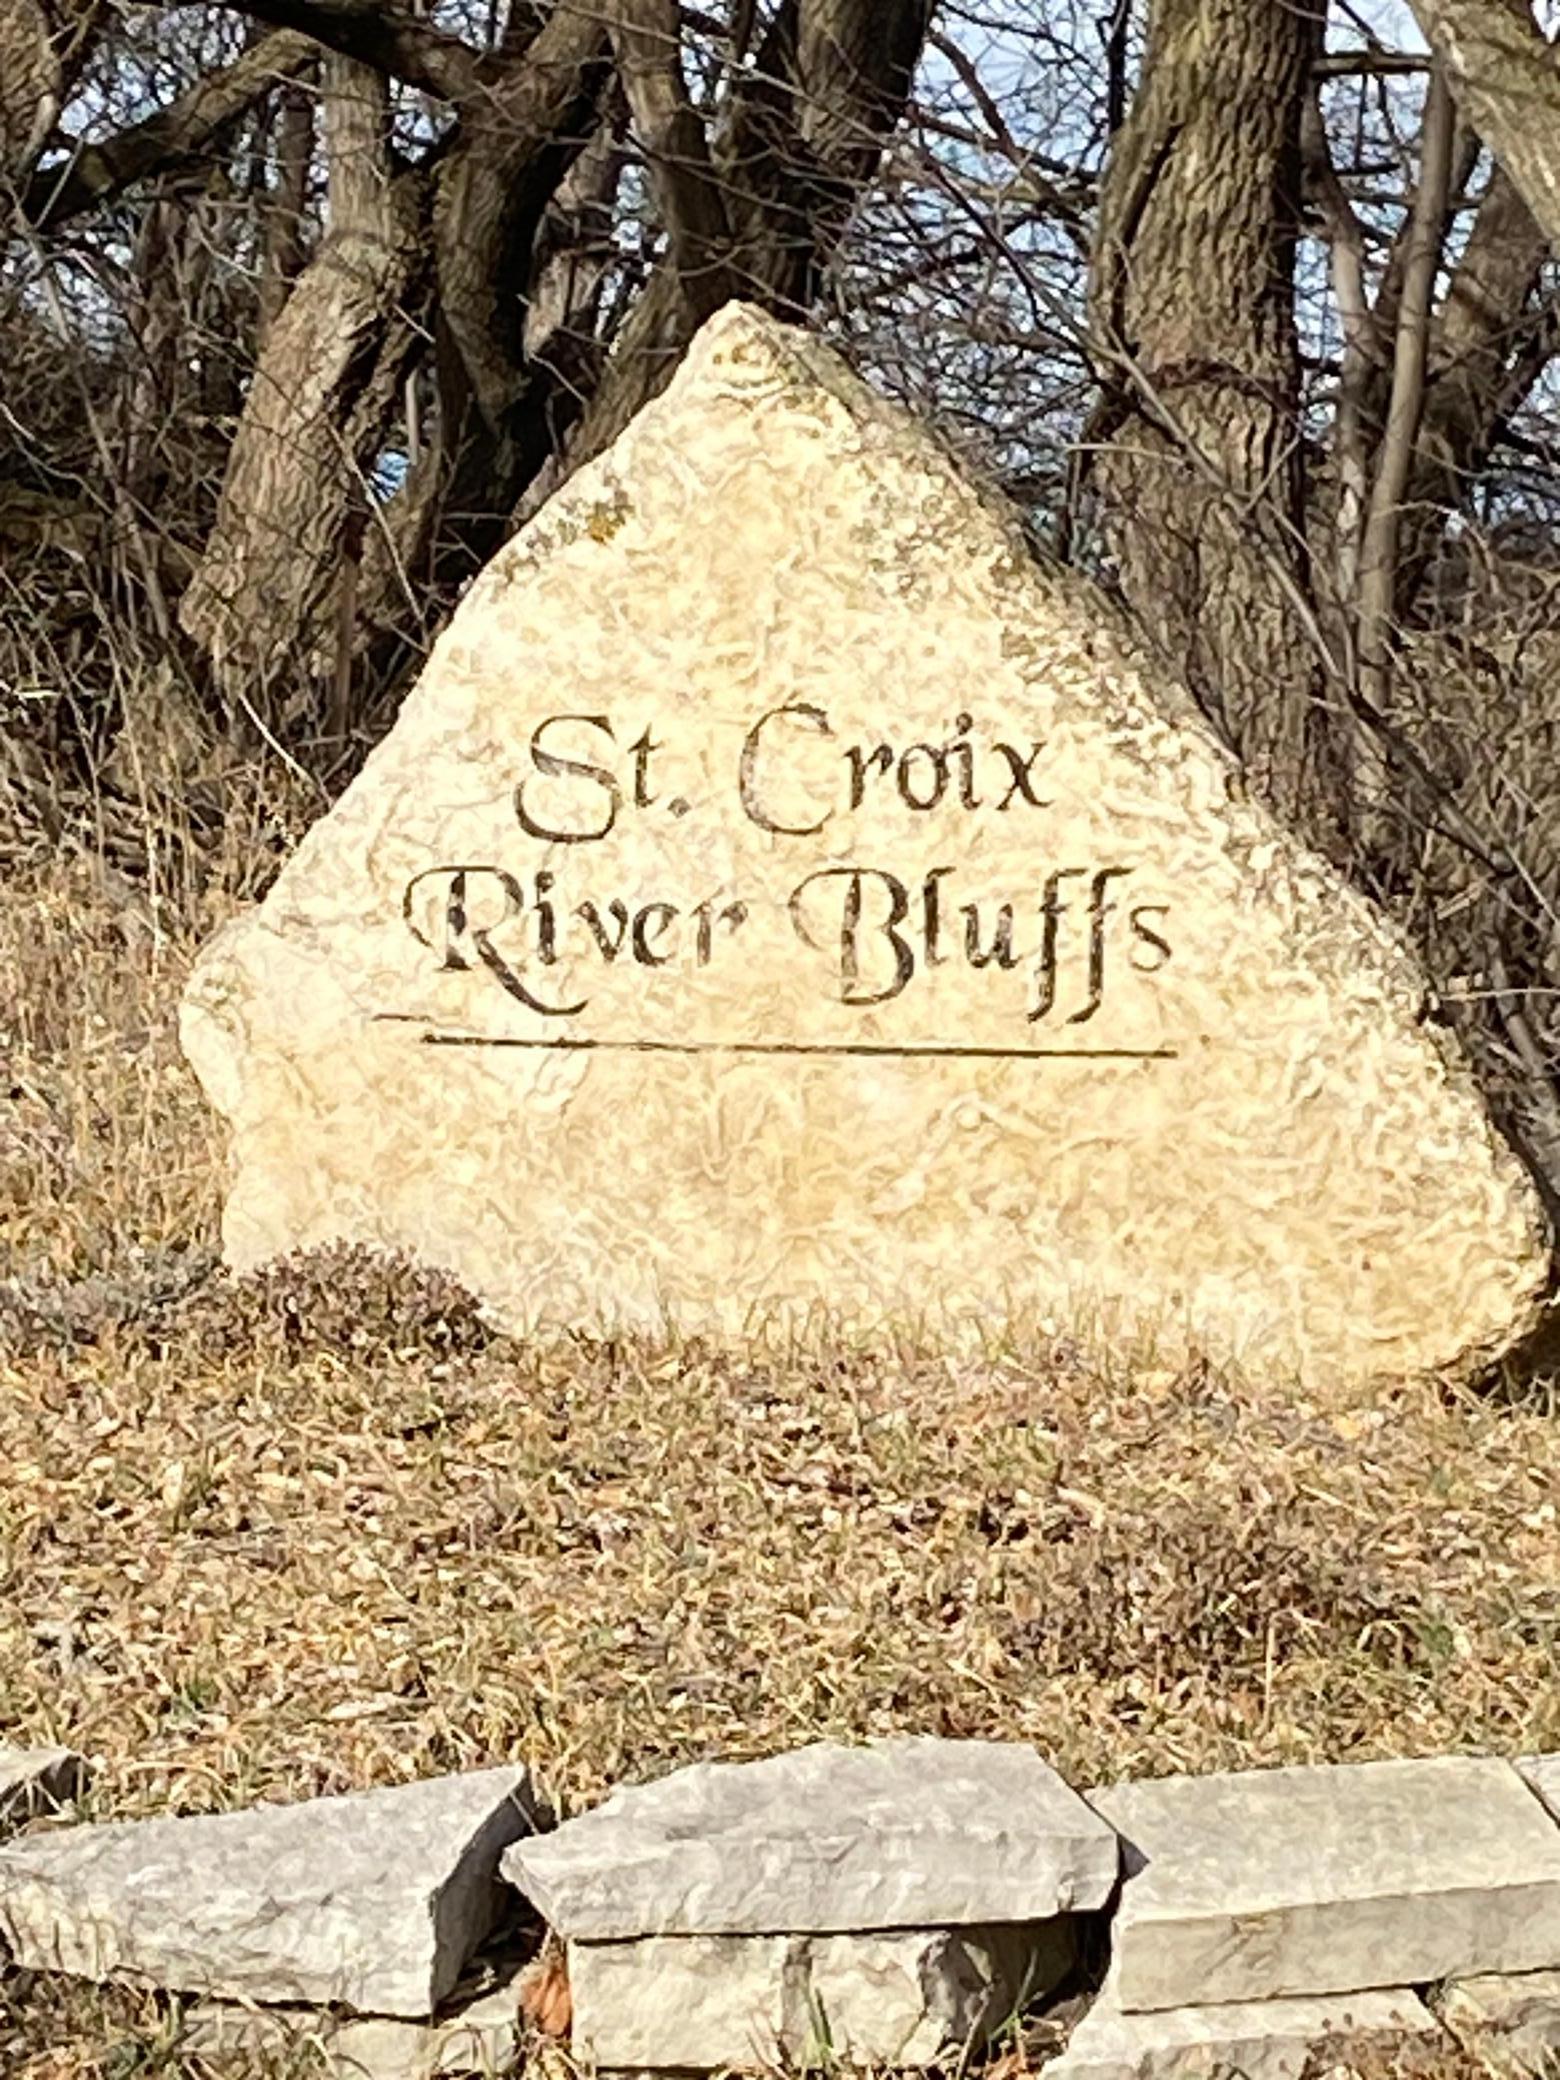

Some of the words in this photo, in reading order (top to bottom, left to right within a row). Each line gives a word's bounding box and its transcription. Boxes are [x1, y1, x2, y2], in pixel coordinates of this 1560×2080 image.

[513, 714, 691, 844] St.
[739, 702, 1054, 836] Croix
[403, 865, 748, 1017] River
[787, 866, 1172, 1024] Bluffs
